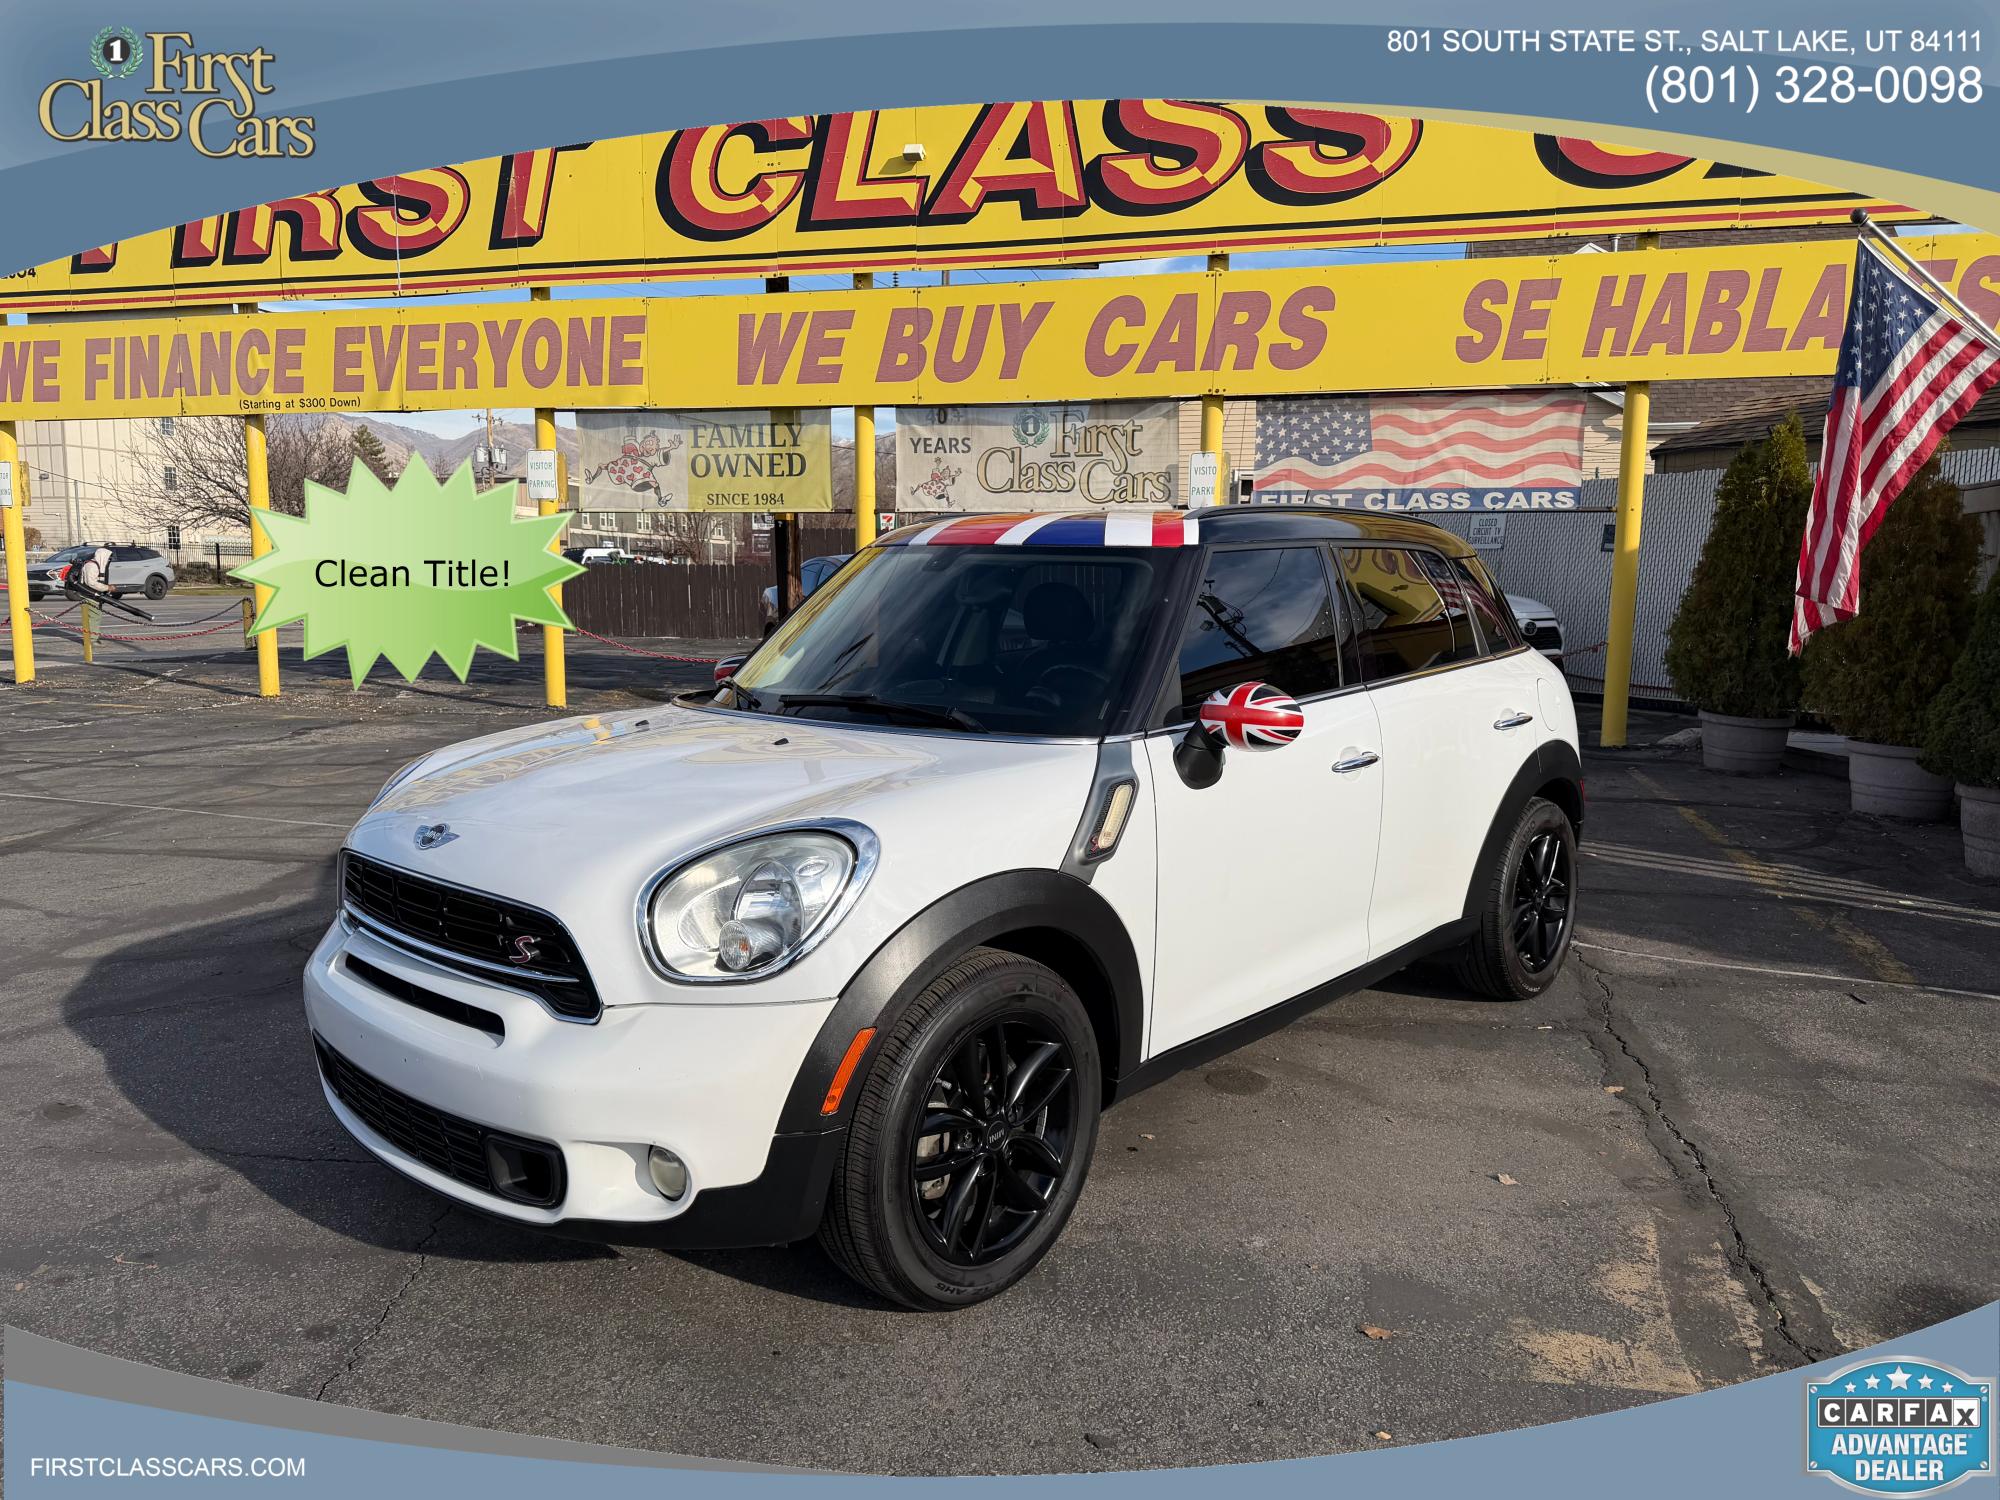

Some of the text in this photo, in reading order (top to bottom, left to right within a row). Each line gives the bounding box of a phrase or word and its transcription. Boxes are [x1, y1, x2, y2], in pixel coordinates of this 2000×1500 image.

[655, 99, 1424, 241] CLASS
[0, 340, 60, 402] WE
[85, 328, 306, 400] FINANCE
[333, 315, 647, 393] EVERYONE
[737, 310, 856, 385] WE
[875, 301, 1055, 383] BUY
[1084, 285, 1336, 378] CARS
[1455, 278, 1561, 363] SE
[1582, 264, 1847, 358] HABLA
[239, 396, 361, 411] (Starting at $300 Down)
[690, 422, 805, 449] FAMILY
[1050, 409, 1144, 474] First
[909, 437, 972, 454] YEARS
[529, 461, 553, 470] VISITOR
[690, 452, 807, 478] OWNED
[977, 446, 1076, 493] Class
[1193, 466, 1217, 476] VISITO
[529, 479, 555, 488] PARKING
[1079, 458, 1172, 504] Cars
[707, 493, 785, 506] SINCE 1984
[1363, 491, 1472, 510] CLASS
[1483, 491, 1576, 509] CARS
[1478, 518, 1498, 527] CLOSED
